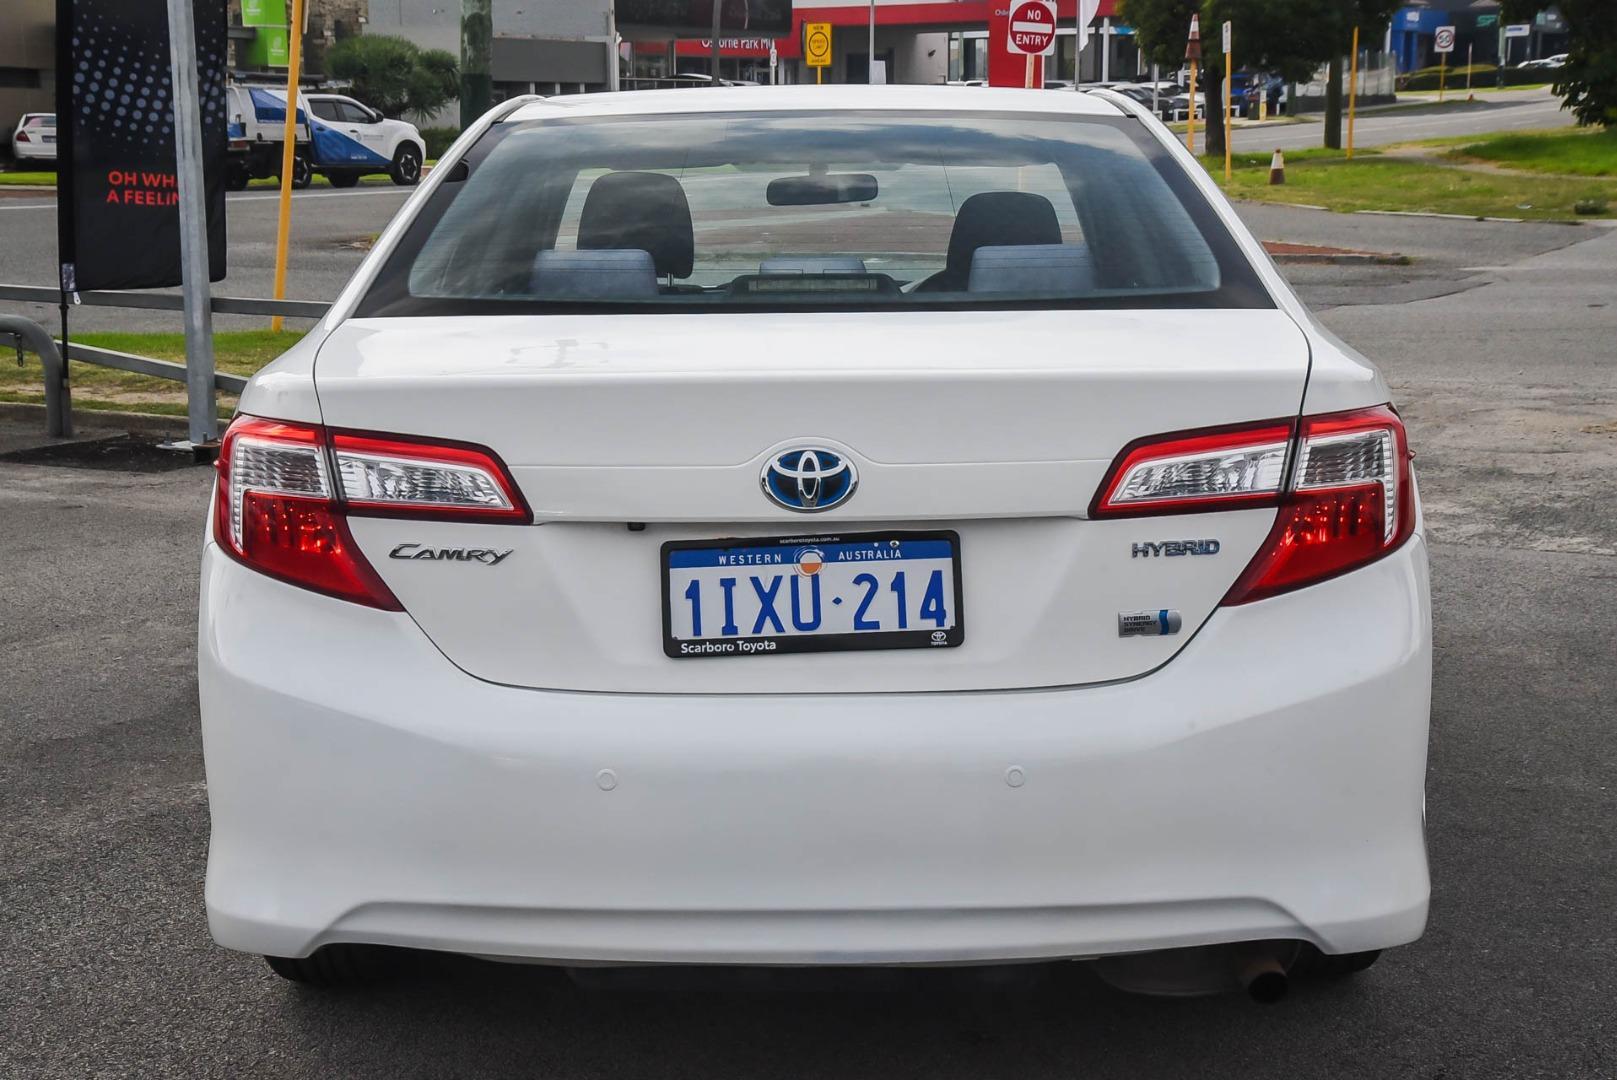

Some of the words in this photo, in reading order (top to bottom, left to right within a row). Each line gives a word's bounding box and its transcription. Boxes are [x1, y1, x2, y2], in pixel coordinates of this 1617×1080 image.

[1027, 9, 1042, 21] NO
[1015, 33, 1049, 47] ENTRY
[1438, 34, 1451, 45] 50
[108, 170, 137, 186] OH
[141, 172, 178, 188] WH
[106, 189, 119, 203] A
[124, 189, 180, 206] FEELIN
[1131, 539, 1220, 558] HYBRID
[718, 553, 782, 566] WESTERN
[838, 549, 902, 561] AUSTRALIA
[680, 641, 735, 654] Scarboro
[736, 640, 777, 653] Toyota
